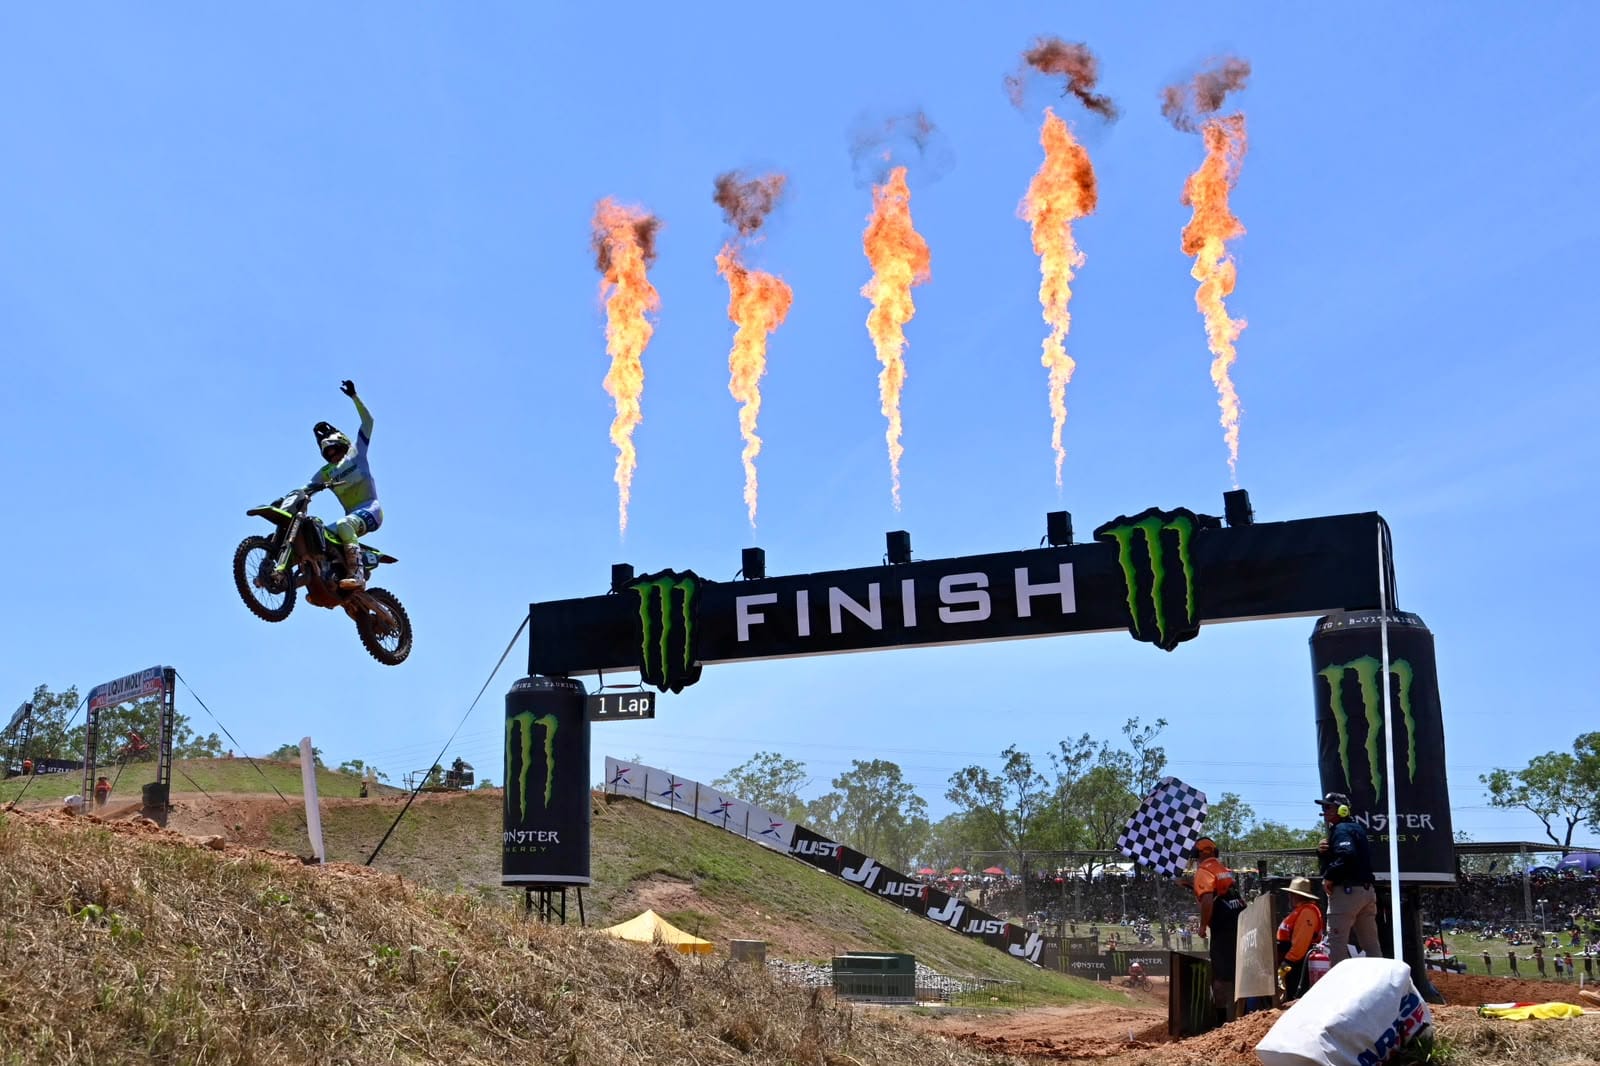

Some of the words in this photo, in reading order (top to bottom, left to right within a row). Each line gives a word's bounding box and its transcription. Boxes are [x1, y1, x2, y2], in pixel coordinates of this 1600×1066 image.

[735, 562, 1076, 641] FINISH
[599, 697, 607, 714] 1
[618, 696, 649, 716] Lap
[1350, 811, 1435, 831] NSER
[503, 829, 560, 845] ONSTER
[1071, 960, 1106, 969] MONSTER
[1129, 957, 1162, 966] MONSTER
